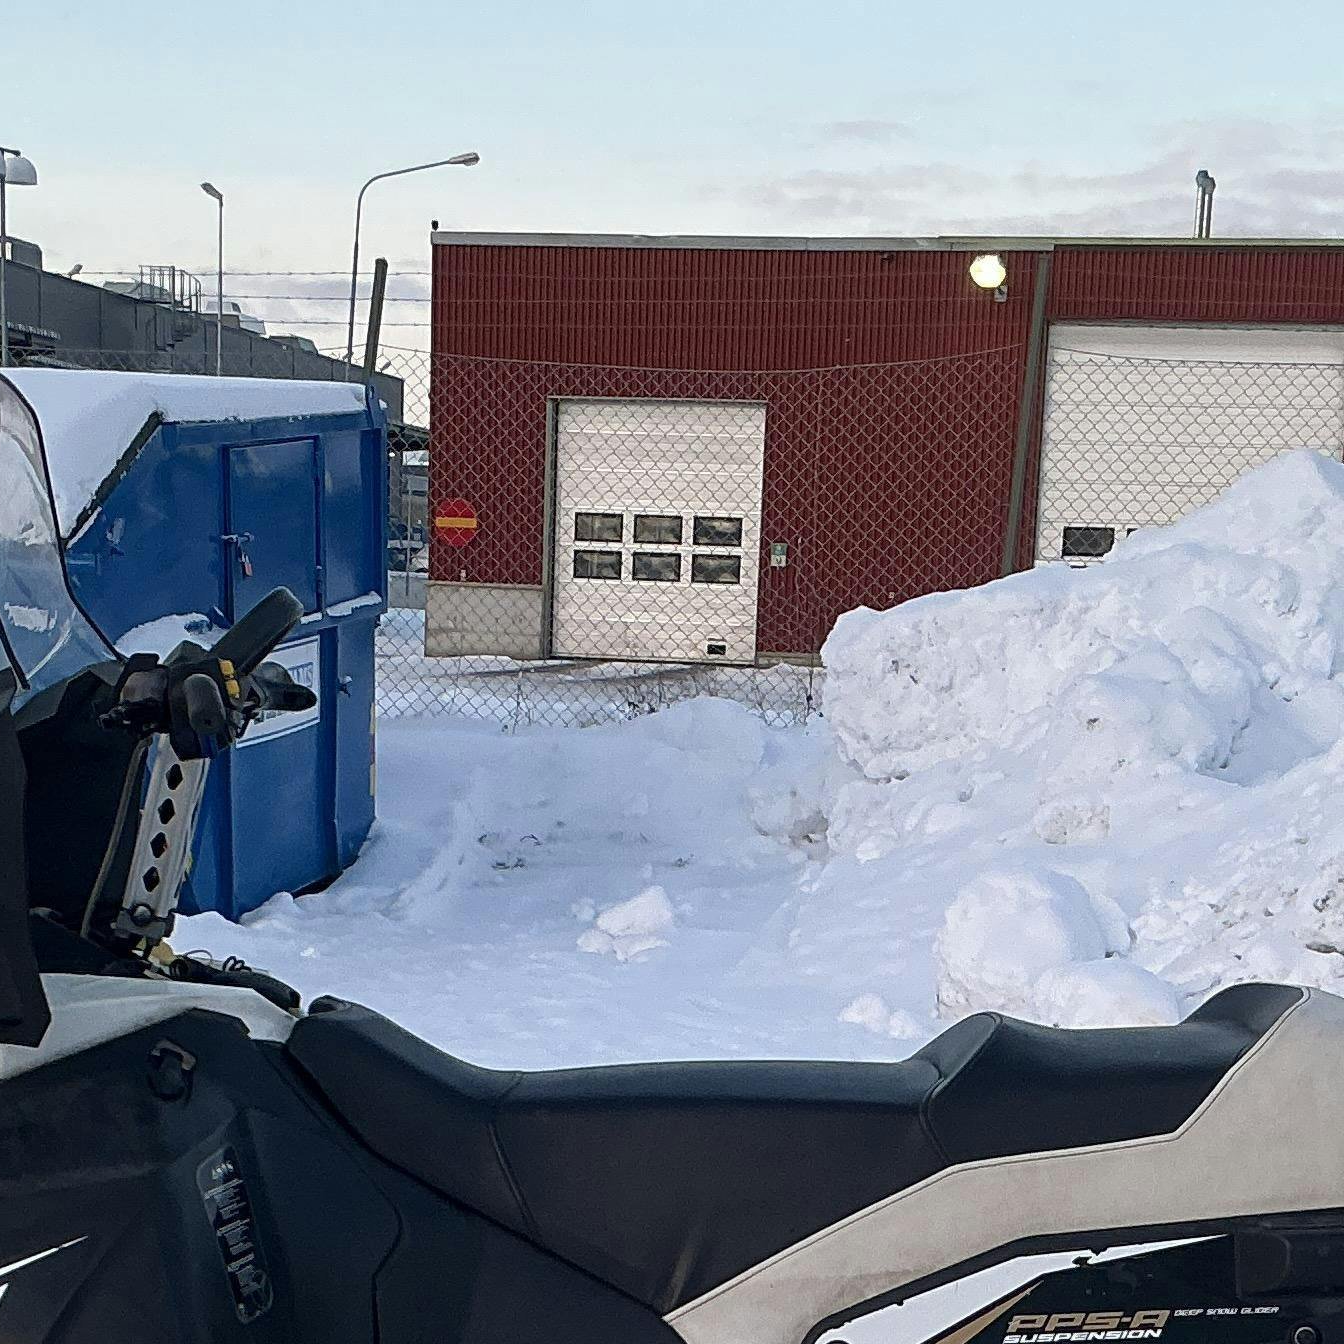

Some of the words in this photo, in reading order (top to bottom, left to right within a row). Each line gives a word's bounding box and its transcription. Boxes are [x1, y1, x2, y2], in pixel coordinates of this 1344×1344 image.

[1007, 1309, 1172, 1334] PPS-A
[1206, 1307, 1239, 1316] SNOW
[1240, 1306, 1280, 1315] GLIDER
[1001, 1328, 1163, 1344] SUSPENSION
